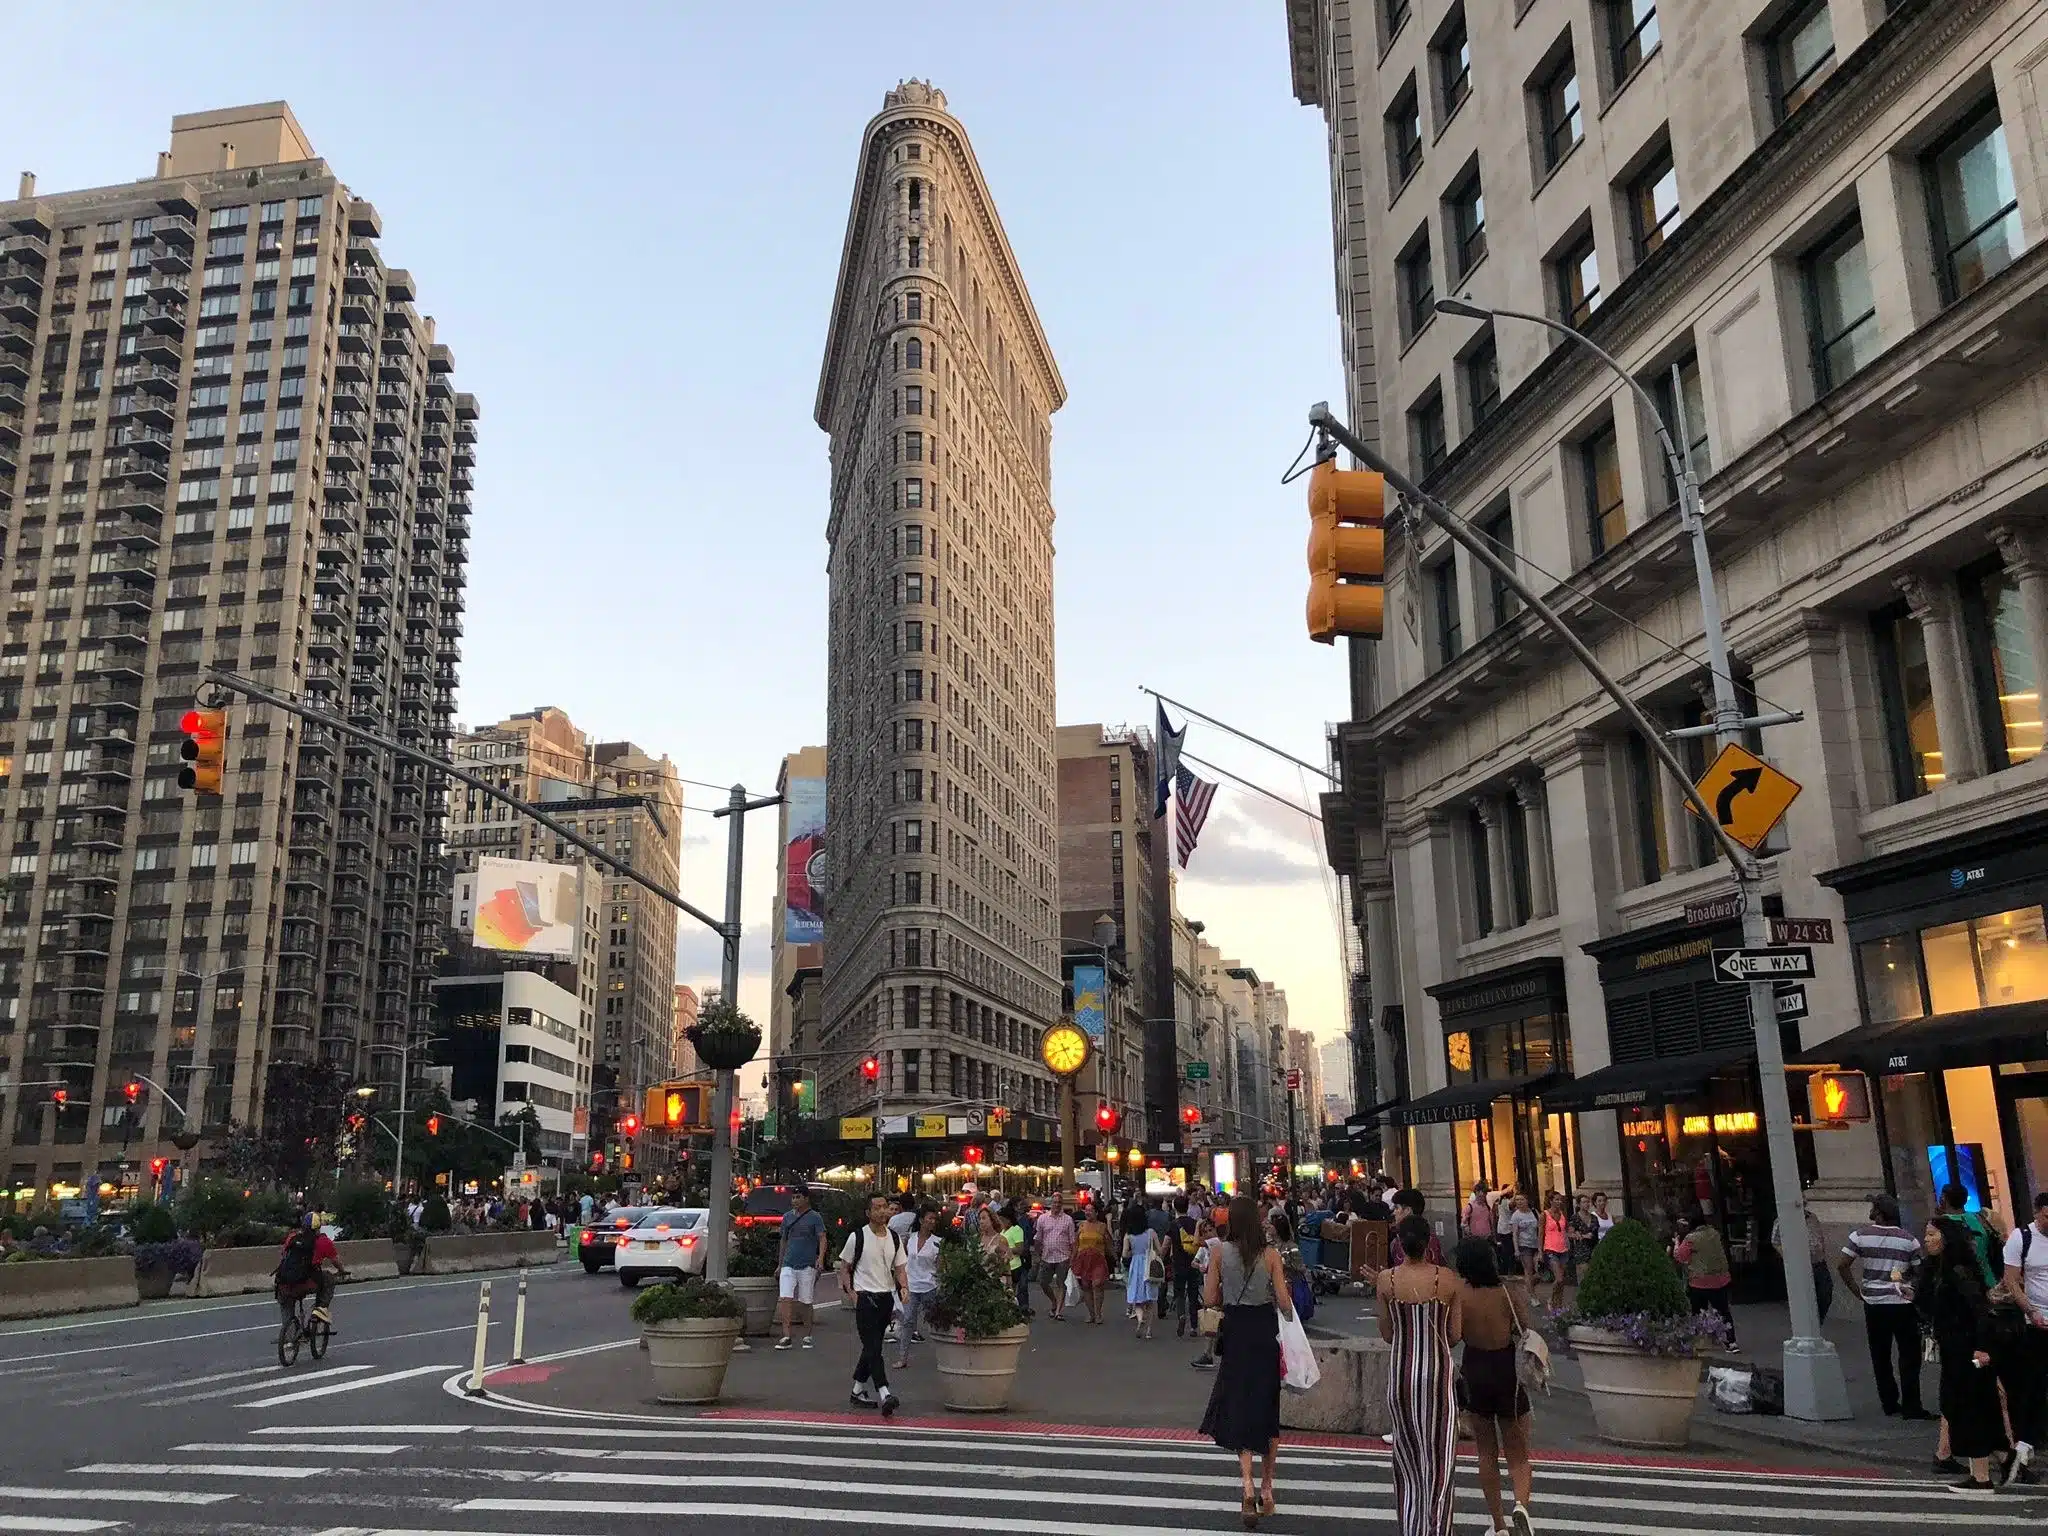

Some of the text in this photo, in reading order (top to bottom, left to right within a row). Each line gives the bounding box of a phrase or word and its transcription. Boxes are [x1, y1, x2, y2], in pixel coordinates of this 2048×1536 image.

[1966, 867, 1985, 881] AT&T
[1687, 901, 1737, 924] Broadway
[1776, 924, 1829, 941] W 24 St
[1730, 957, 1800, 972] ONE WAY
[1511, 981, 1536, 997] FOOD
[1780, 995, 1798, 1010] WAY
[1888, 1055, 1908, 1068] AT&T
[1403, 1108, 1438, 1124] EATALY
[844, 1125, 864, 1134] Sprint
[917, 1124, 937, 1133] print
[514, 1159, 526, 1167] 25
